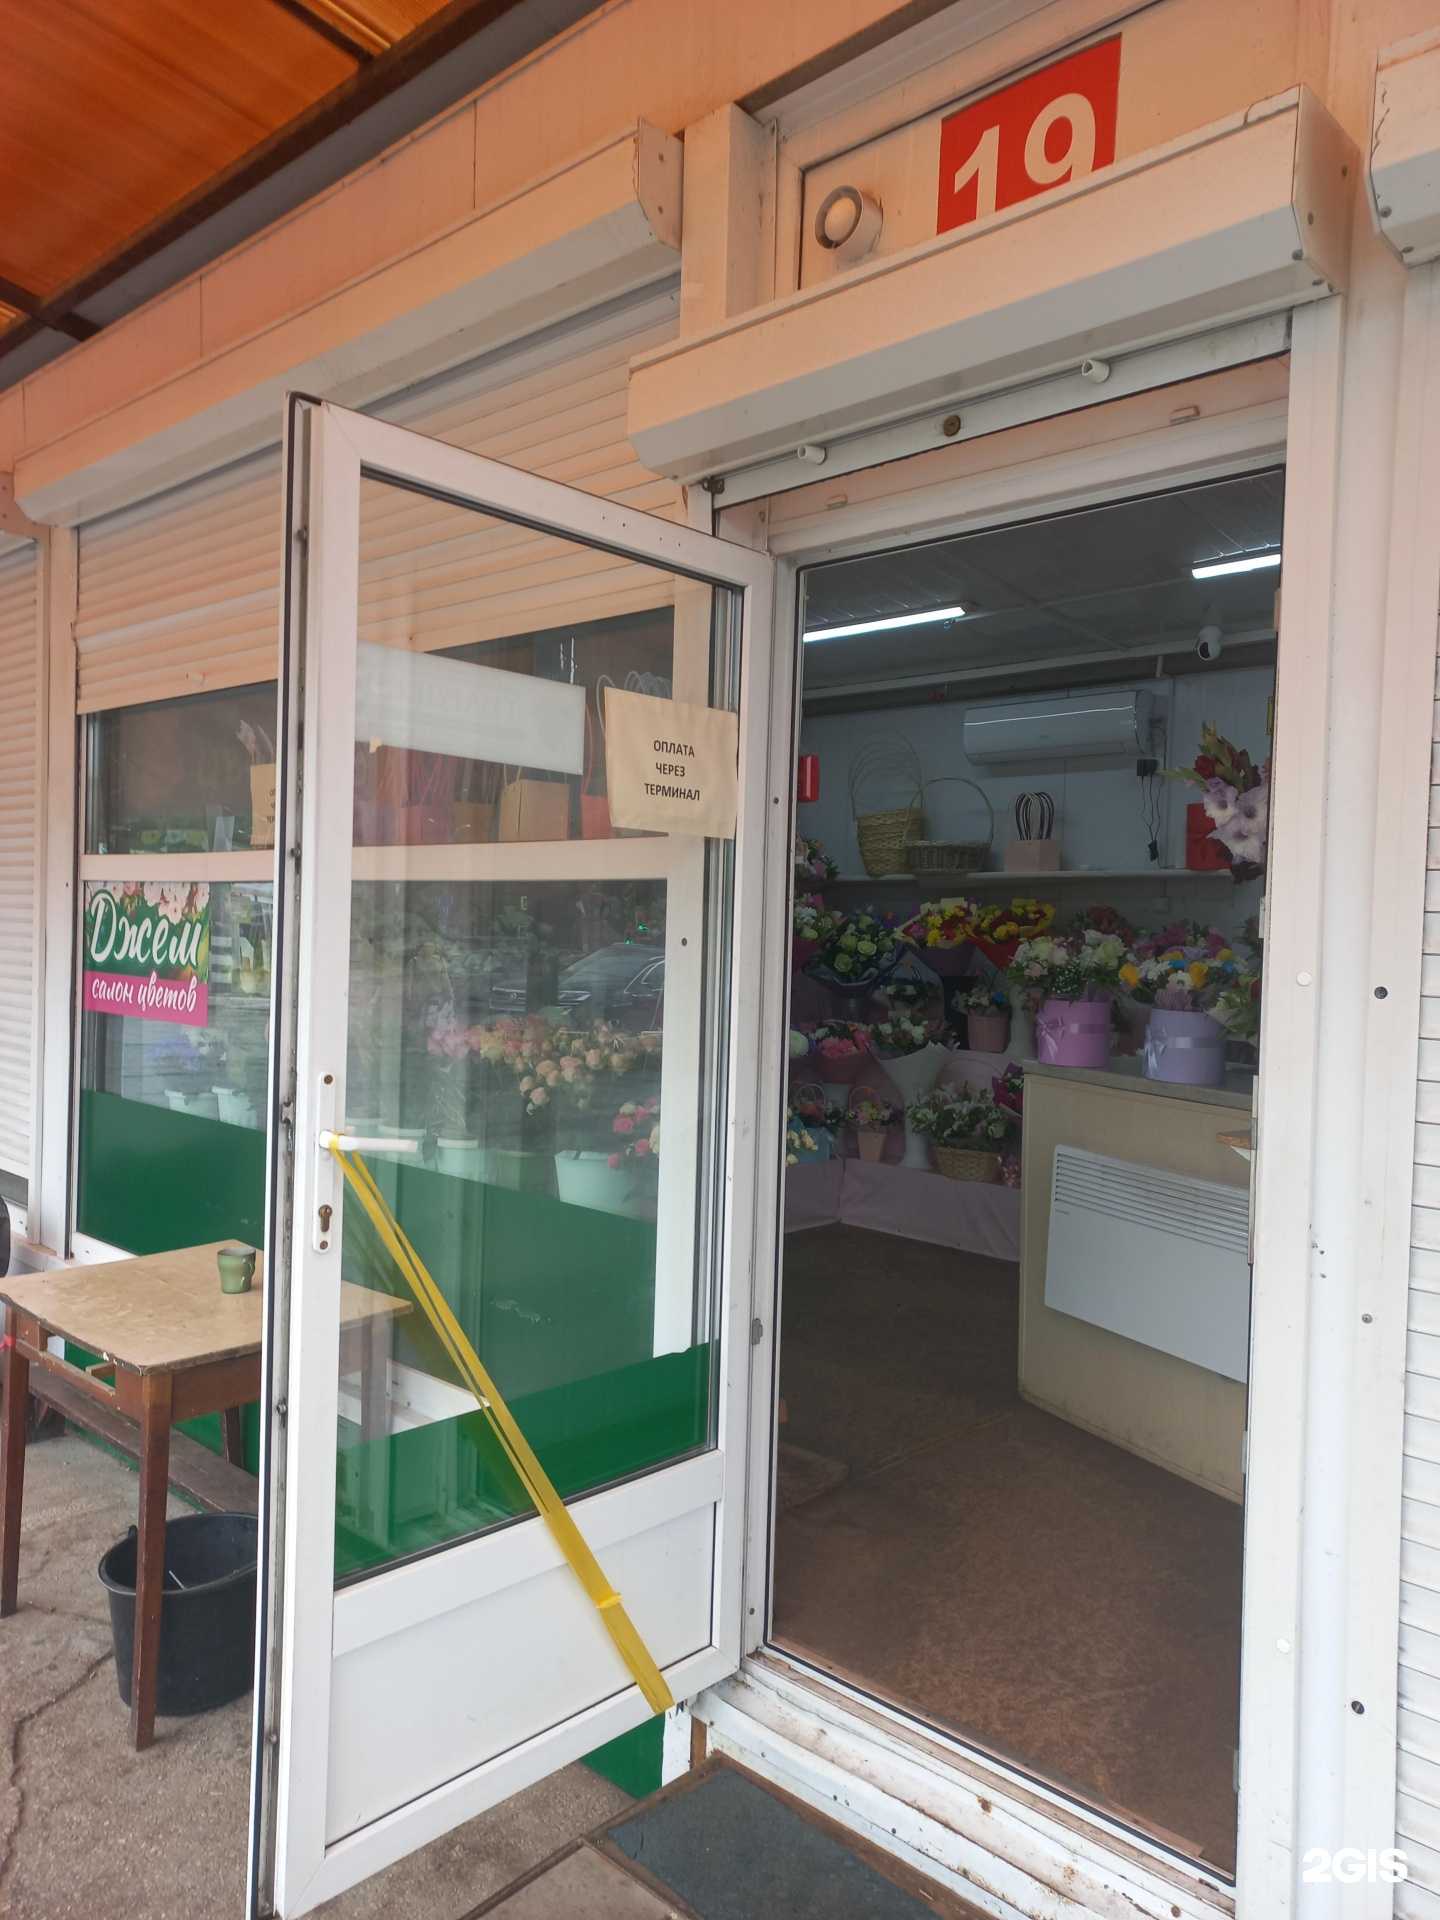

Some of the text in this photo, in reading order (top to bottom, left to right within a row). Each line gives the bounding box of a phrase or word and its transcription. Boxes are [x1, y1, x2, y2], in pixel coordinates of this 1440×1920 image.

[953, 91, 1097, 220] 19
[653, 739, 695, 758] ОПЛАТА
[655, 762, 686, 778] ЧЕРЕЗ
[644, 782, 701, 801] ТЕРМИНАЛ
[90, 890, 201, 967] Джем
[92, 970, 198, 1013] салон цветов
